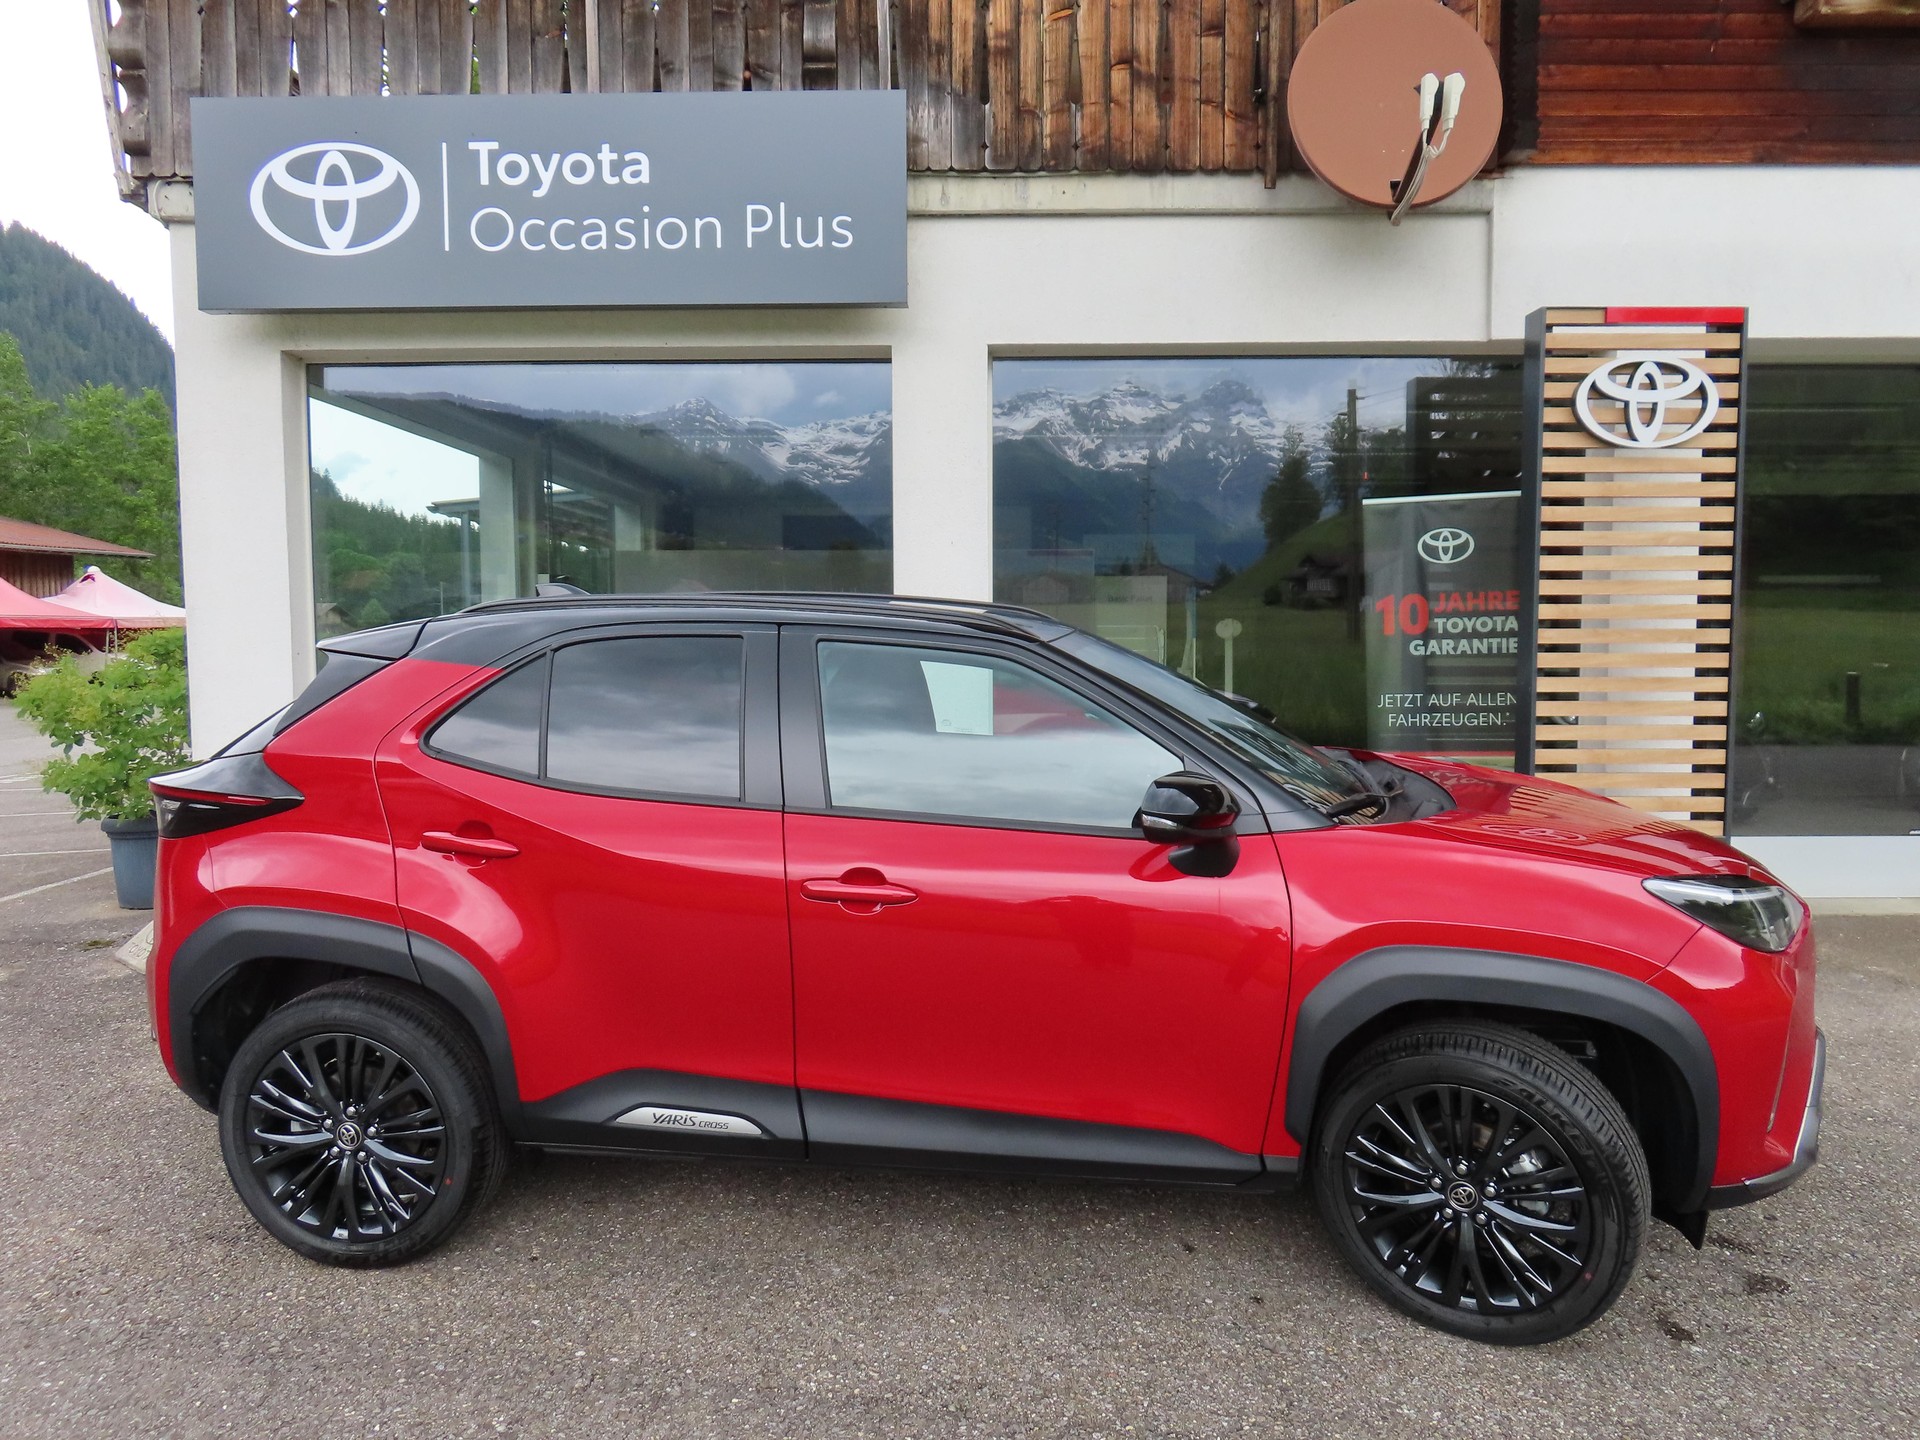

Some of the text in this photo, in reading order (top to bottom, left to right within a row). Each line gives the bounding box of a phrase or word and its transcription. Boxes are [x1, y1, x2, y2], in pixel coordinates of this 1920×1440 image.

[468, 141, 650, 197] Toyota
[469, 202, 855, 252] Occasion Plus
[1375, 590, 1520, 636] 10 JAHRE
[1434, 615, 1518, 633] TOYOTA
[1409, 637, 1518, 655] GARANTIE
[1377, 694, 1423, 708] JETZT
[1428, 693, 1461, 707] AUF
[698, 1120, 729, 1130] CROSS
